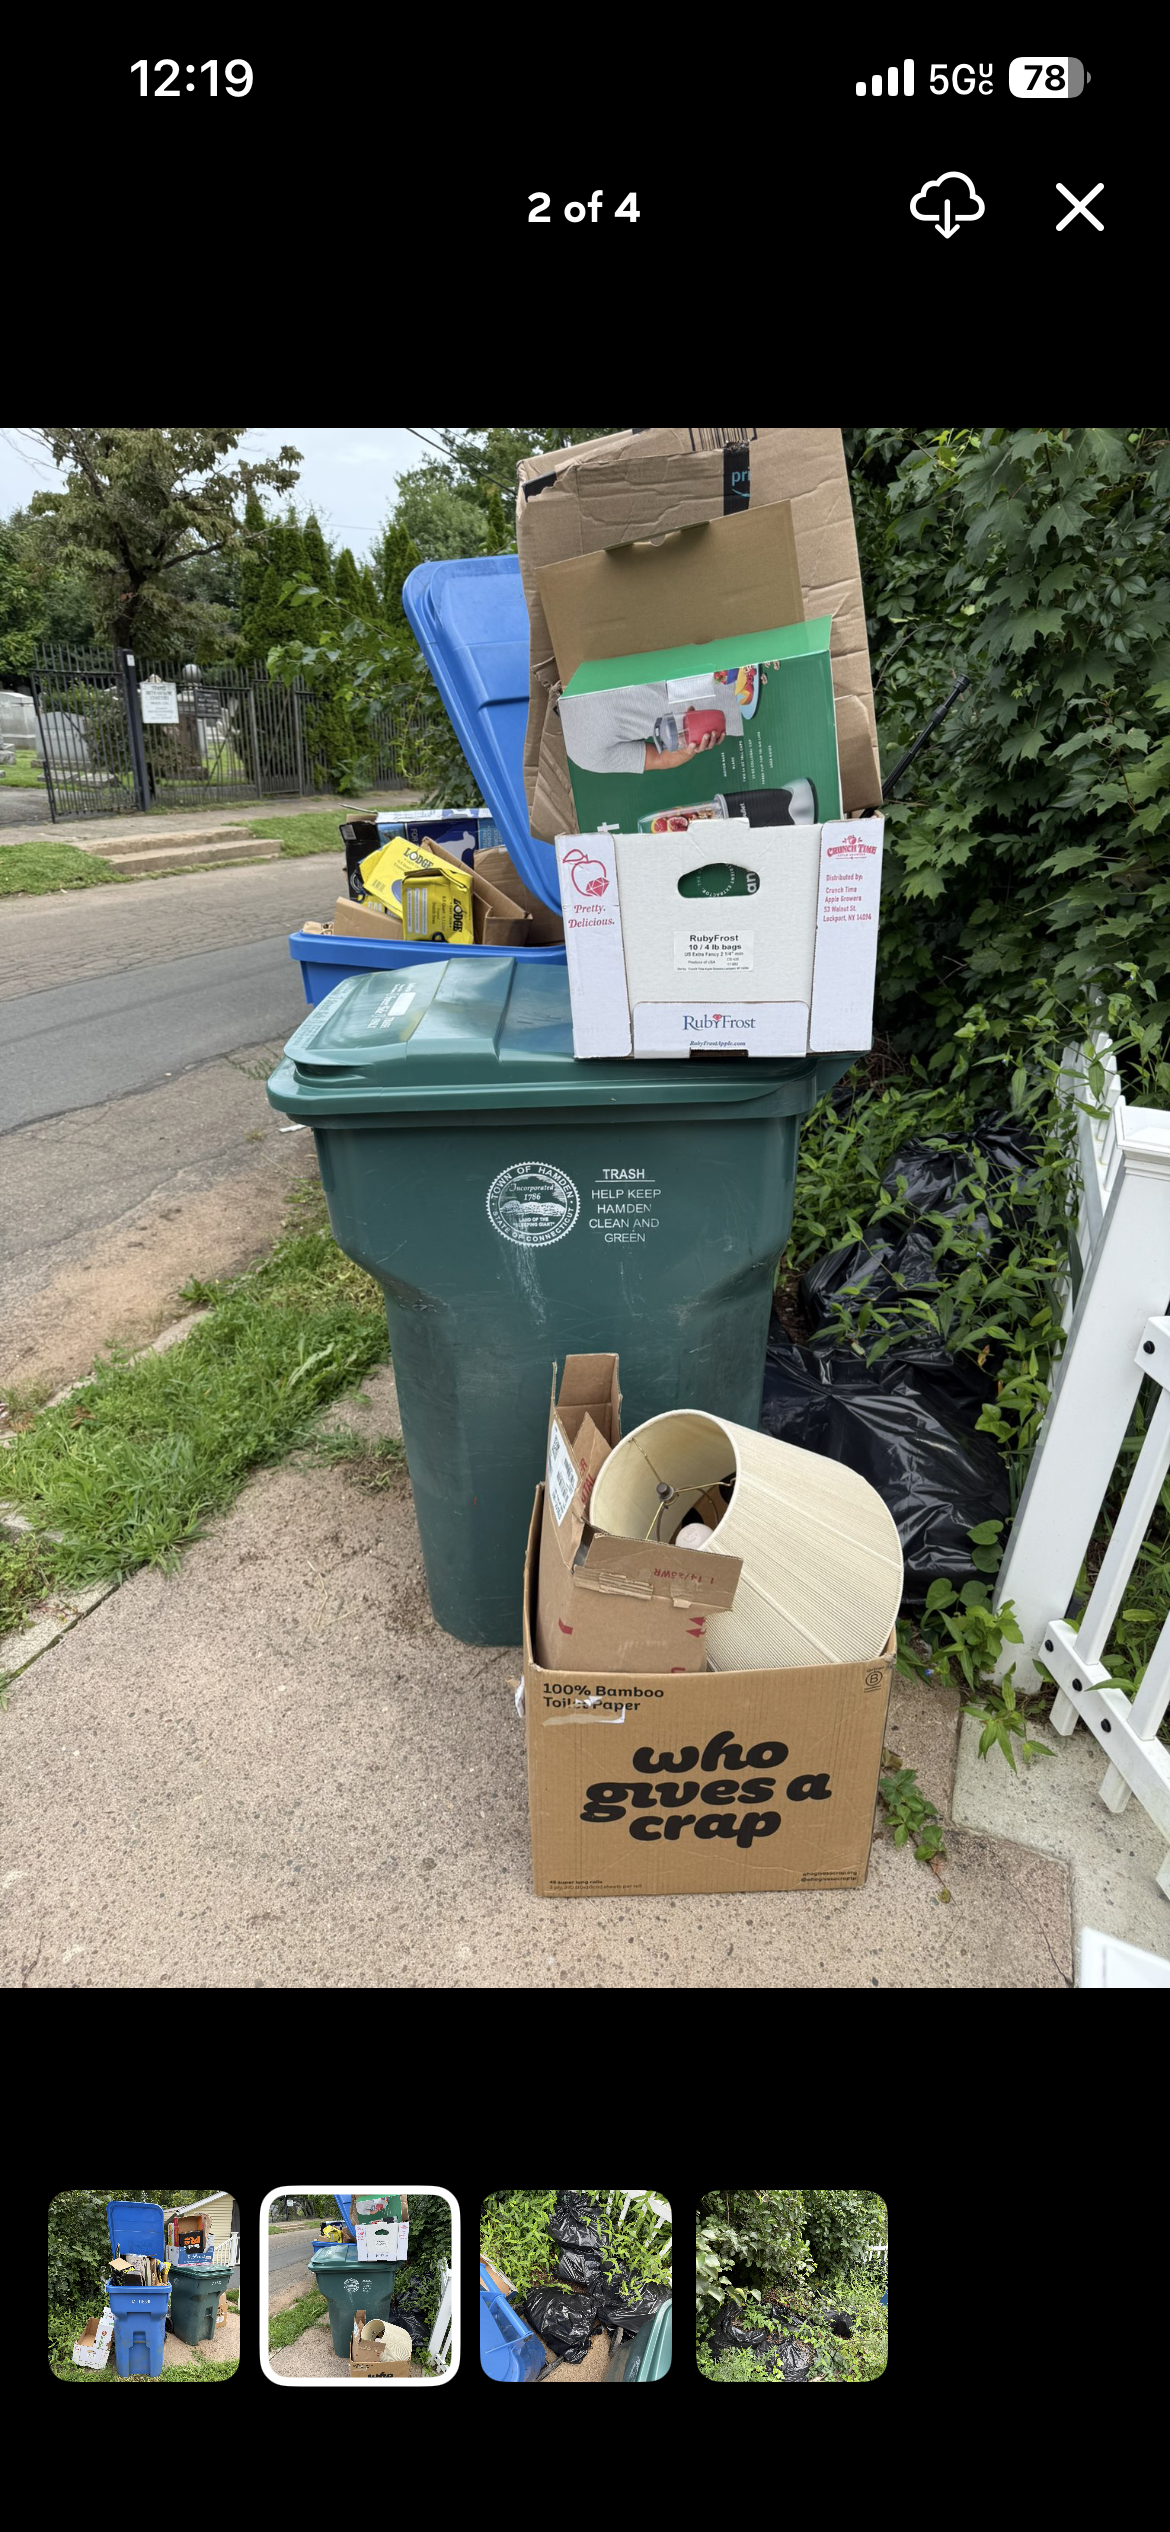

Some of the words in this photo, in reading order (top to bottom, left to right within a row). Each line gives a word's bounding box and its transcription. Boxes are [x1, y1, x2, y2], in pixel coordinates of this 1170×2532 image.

[410, 828, 418, 842] FOR
[827, 844, 857, 857] CRUNCH
[858, 844, 878, 854] TIME
[404, 847, 434, 868] LODGE
[453, 898, 464, 932] LODGE
[574, 904, 606, 914] Pretty.
[568, 918, 614, 928] Delicious.
[690, 934, 738, 943] RubyFrost
[682, 1014, 756, 1030] RubyFrost
[602, 1169, 645, 1180] TRASH
[491, 1173, 513, 1200] TOWN
[517, 1166, 532, 1175] OF
[538, 1166, 574, 1199] HAMDEN
[509, 1183, 554, 1192] Incorporated
[524, 1193, 541, 1201] 1786
[592, 1190, 624, 1199] HELP
[628, 1189, 661, 1198] KEEP
[598, 1204, 652, 1214] HAMDEN
[492, 1211, 510, 1233] STATE
[526, 1207, 574, 1242] CONNECTICUT
[589, 1218, 629, 1228] CLEAN
[634, 1218, 660, 1228] AND
[604, 1233, 646, 1242] GREEN
[543, 1683, 591, 1696] 100%
[596, 1686, 664, 1698] Bamboo
[592, 1700, 640, 1712] Paper
[632, 1730, 789, 1774] who
[580, 1777, 776, 1822] gives
[786, 1772, 832, 1802] a
[628, 1810, 782, 1849] crap
